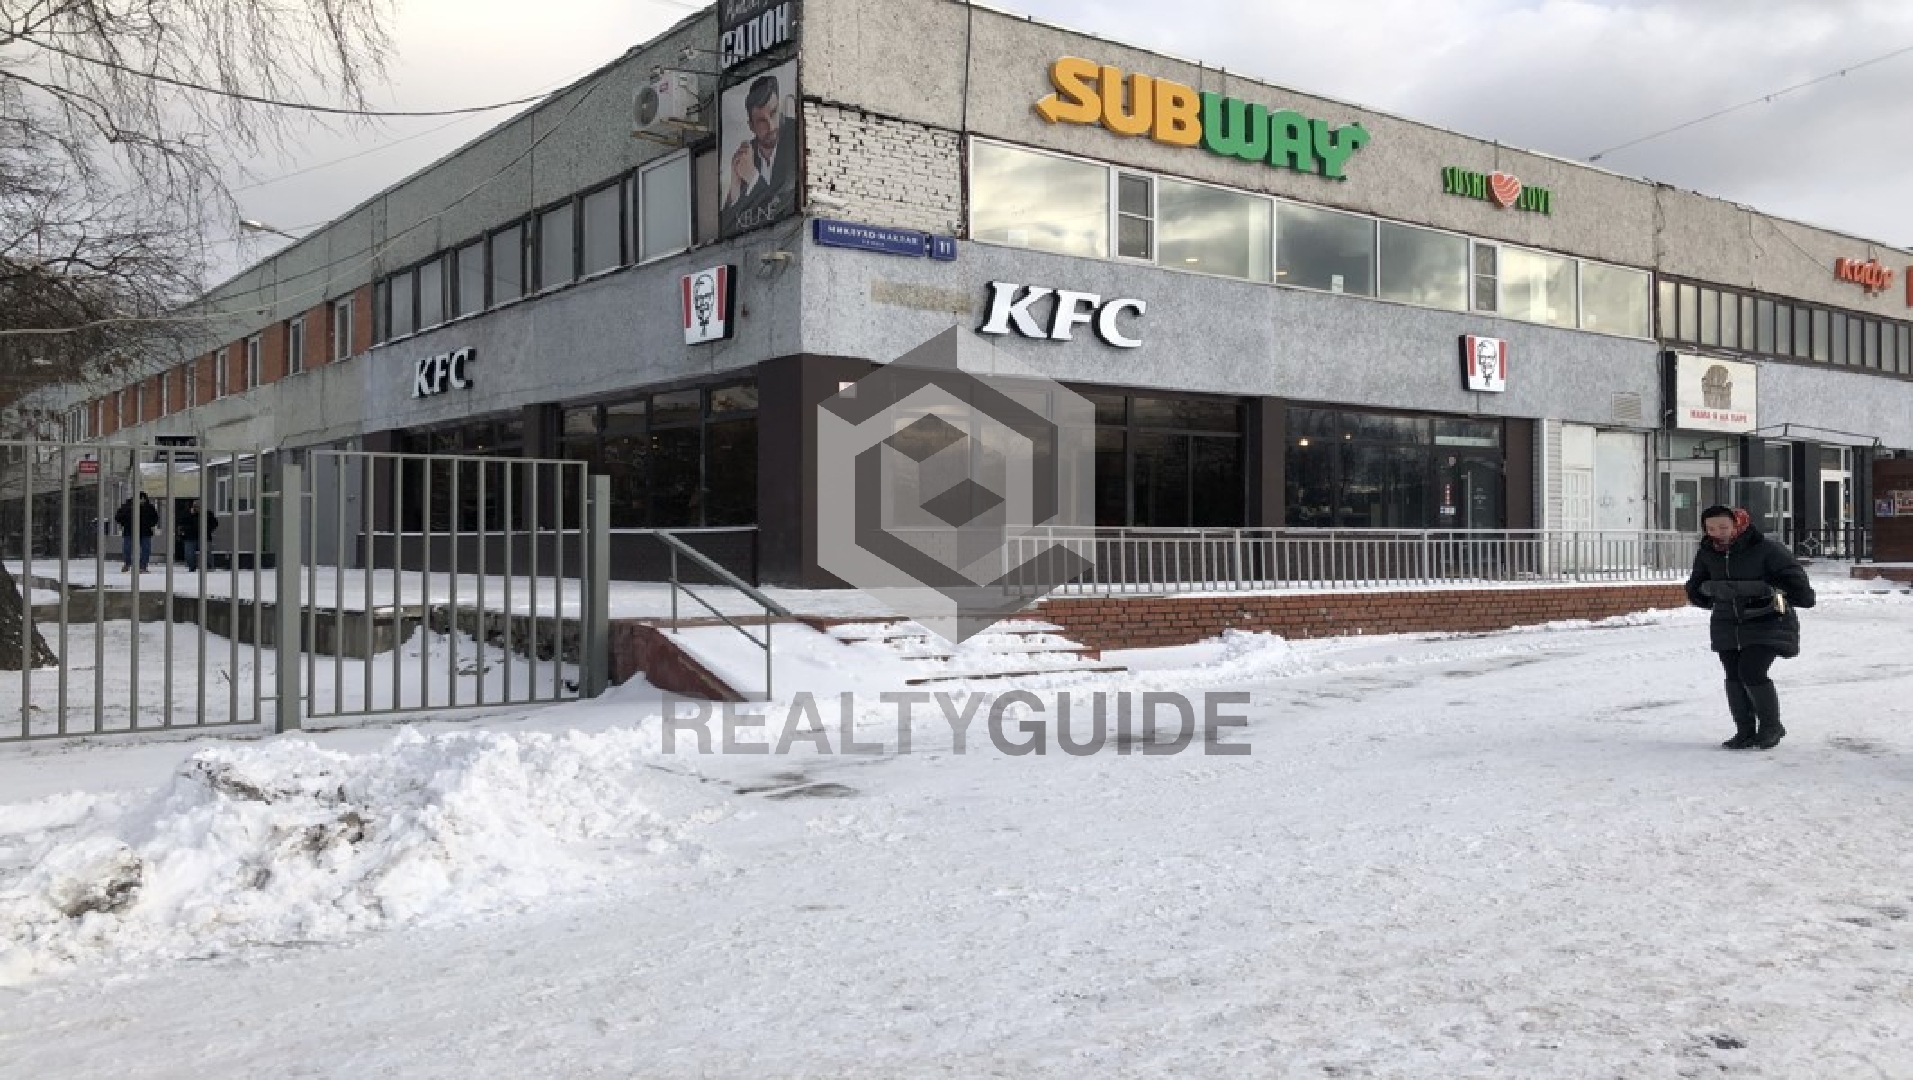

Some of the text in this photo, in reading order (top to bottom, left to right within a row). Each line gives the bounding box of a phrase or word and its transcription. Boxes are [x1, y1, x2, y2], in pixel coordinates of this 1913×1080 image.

[721, 2, 789, 68] САЛОН
[1036, 56, 1371, 180] SUBWAY
[1441, 166, 1487, 201] SUSHI
[940, 240, 951, 254] 11
[978, 281, 1147, 348] KFC
[412, 346, 475, 398] KFC
